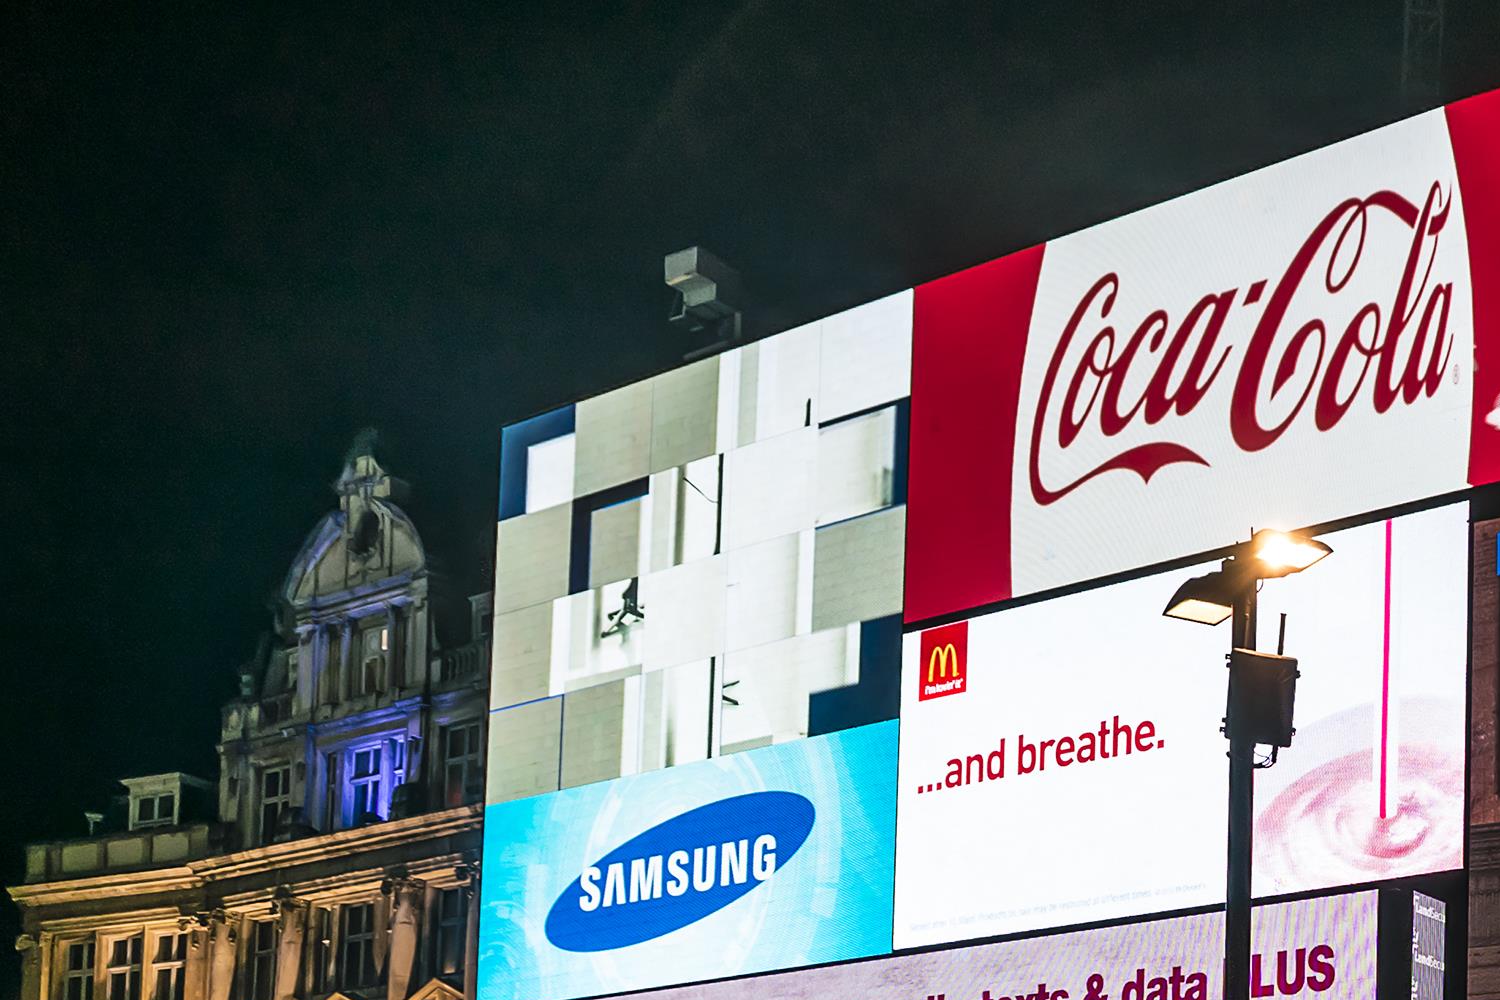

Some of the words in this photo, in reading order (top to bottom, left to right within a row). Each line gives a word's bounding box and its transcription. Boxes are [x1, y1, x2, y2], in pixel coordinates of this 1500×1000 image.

[1029, 180, 1454, 505] Coca-Cola
[1017, 715, 1166, 774] breathe.
[579, 834, 777, 912] SAMSUNG
[1223, 945, 1336, 1000] LUS
